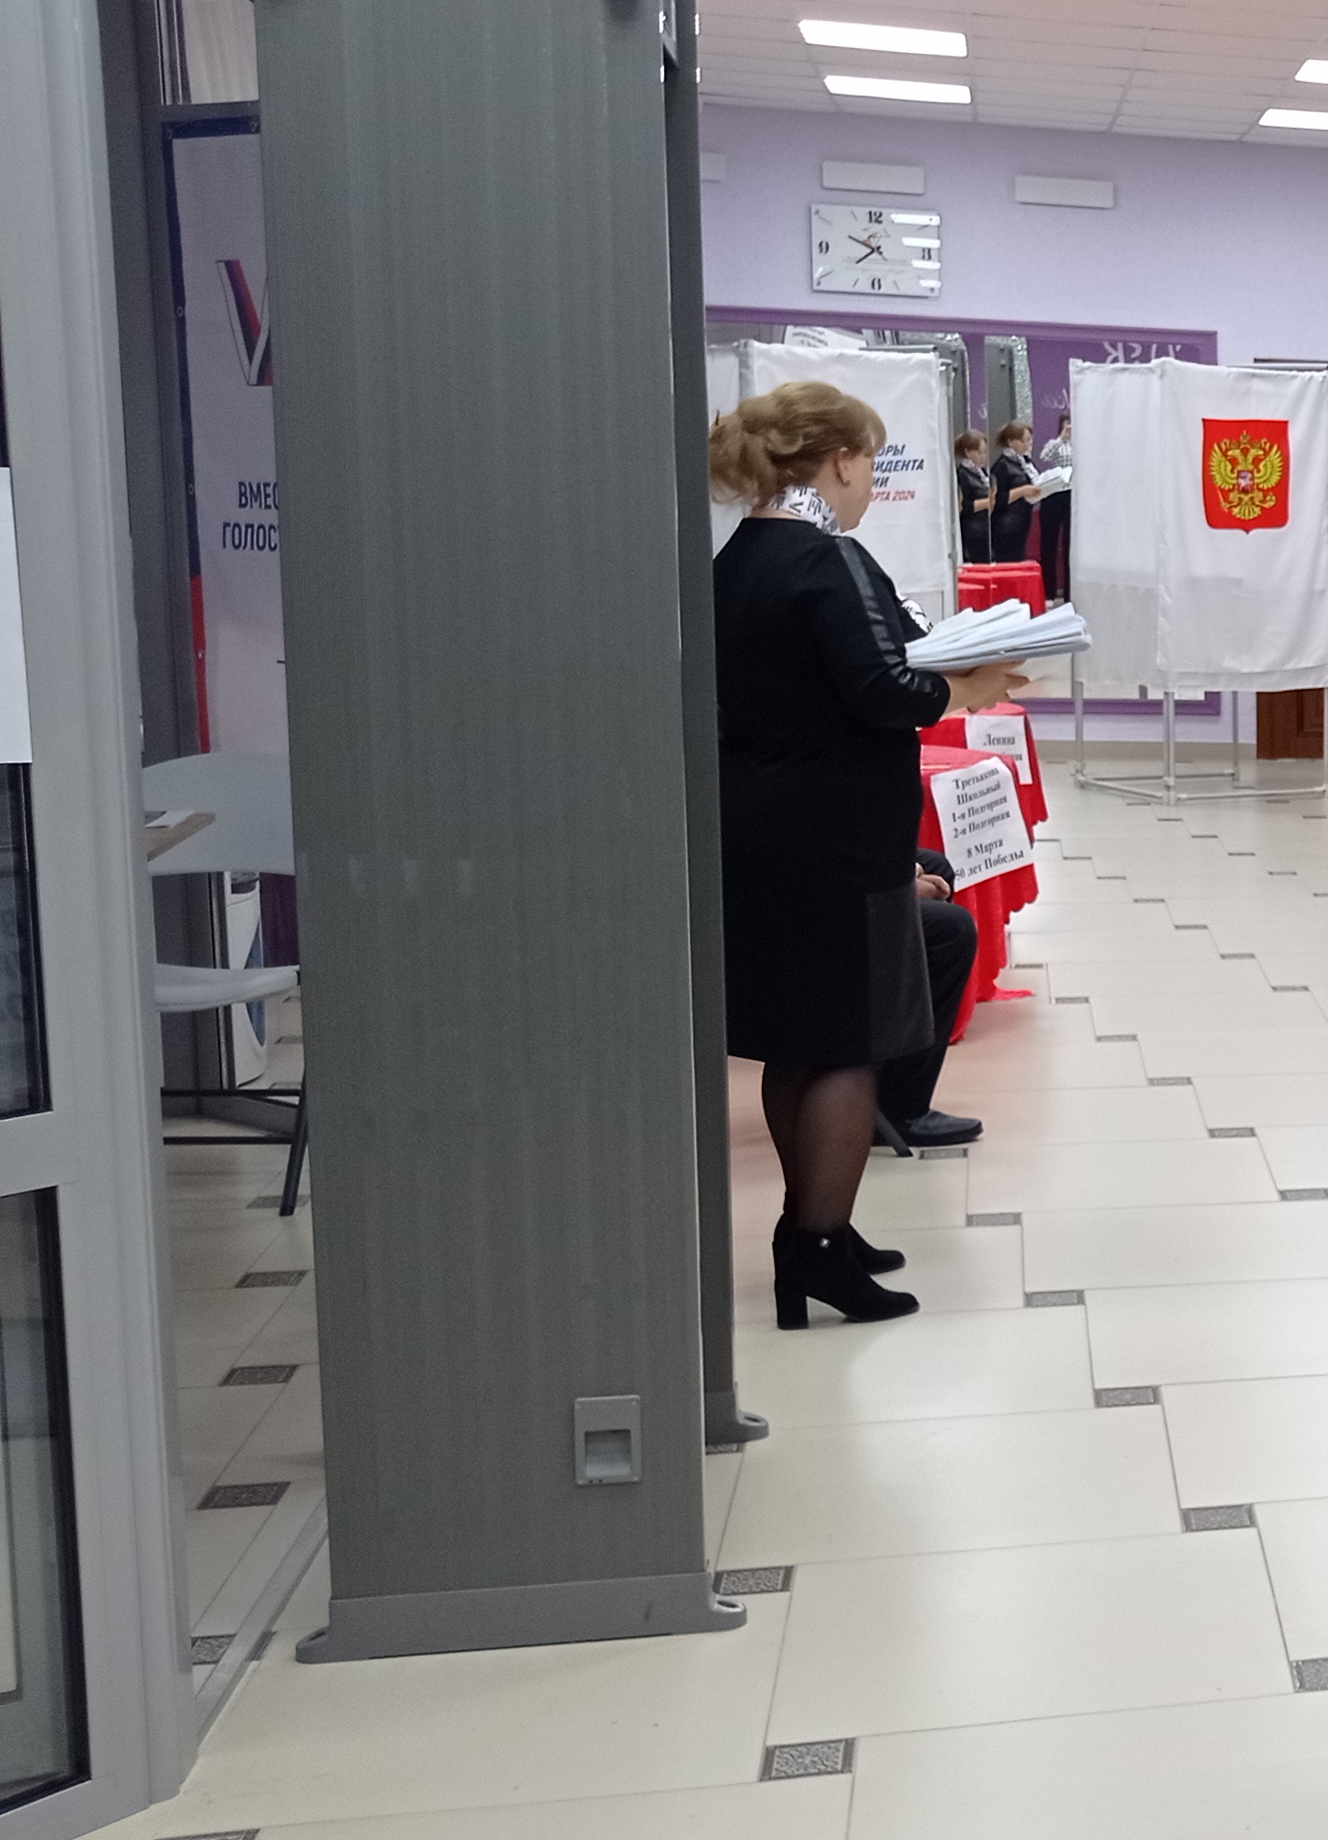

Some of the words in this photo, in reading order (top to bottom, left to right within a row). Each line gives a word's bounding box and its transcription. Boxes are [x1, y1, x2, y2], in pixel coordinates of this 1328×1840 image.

[868, 210, 883, 224] 12
[222, 522, 280, 551] ГОЛОС
[967, 847, 973, 859] 8
[974, 839, 1004, 854] Марта
[984, 850, 1025, 870] Победы
